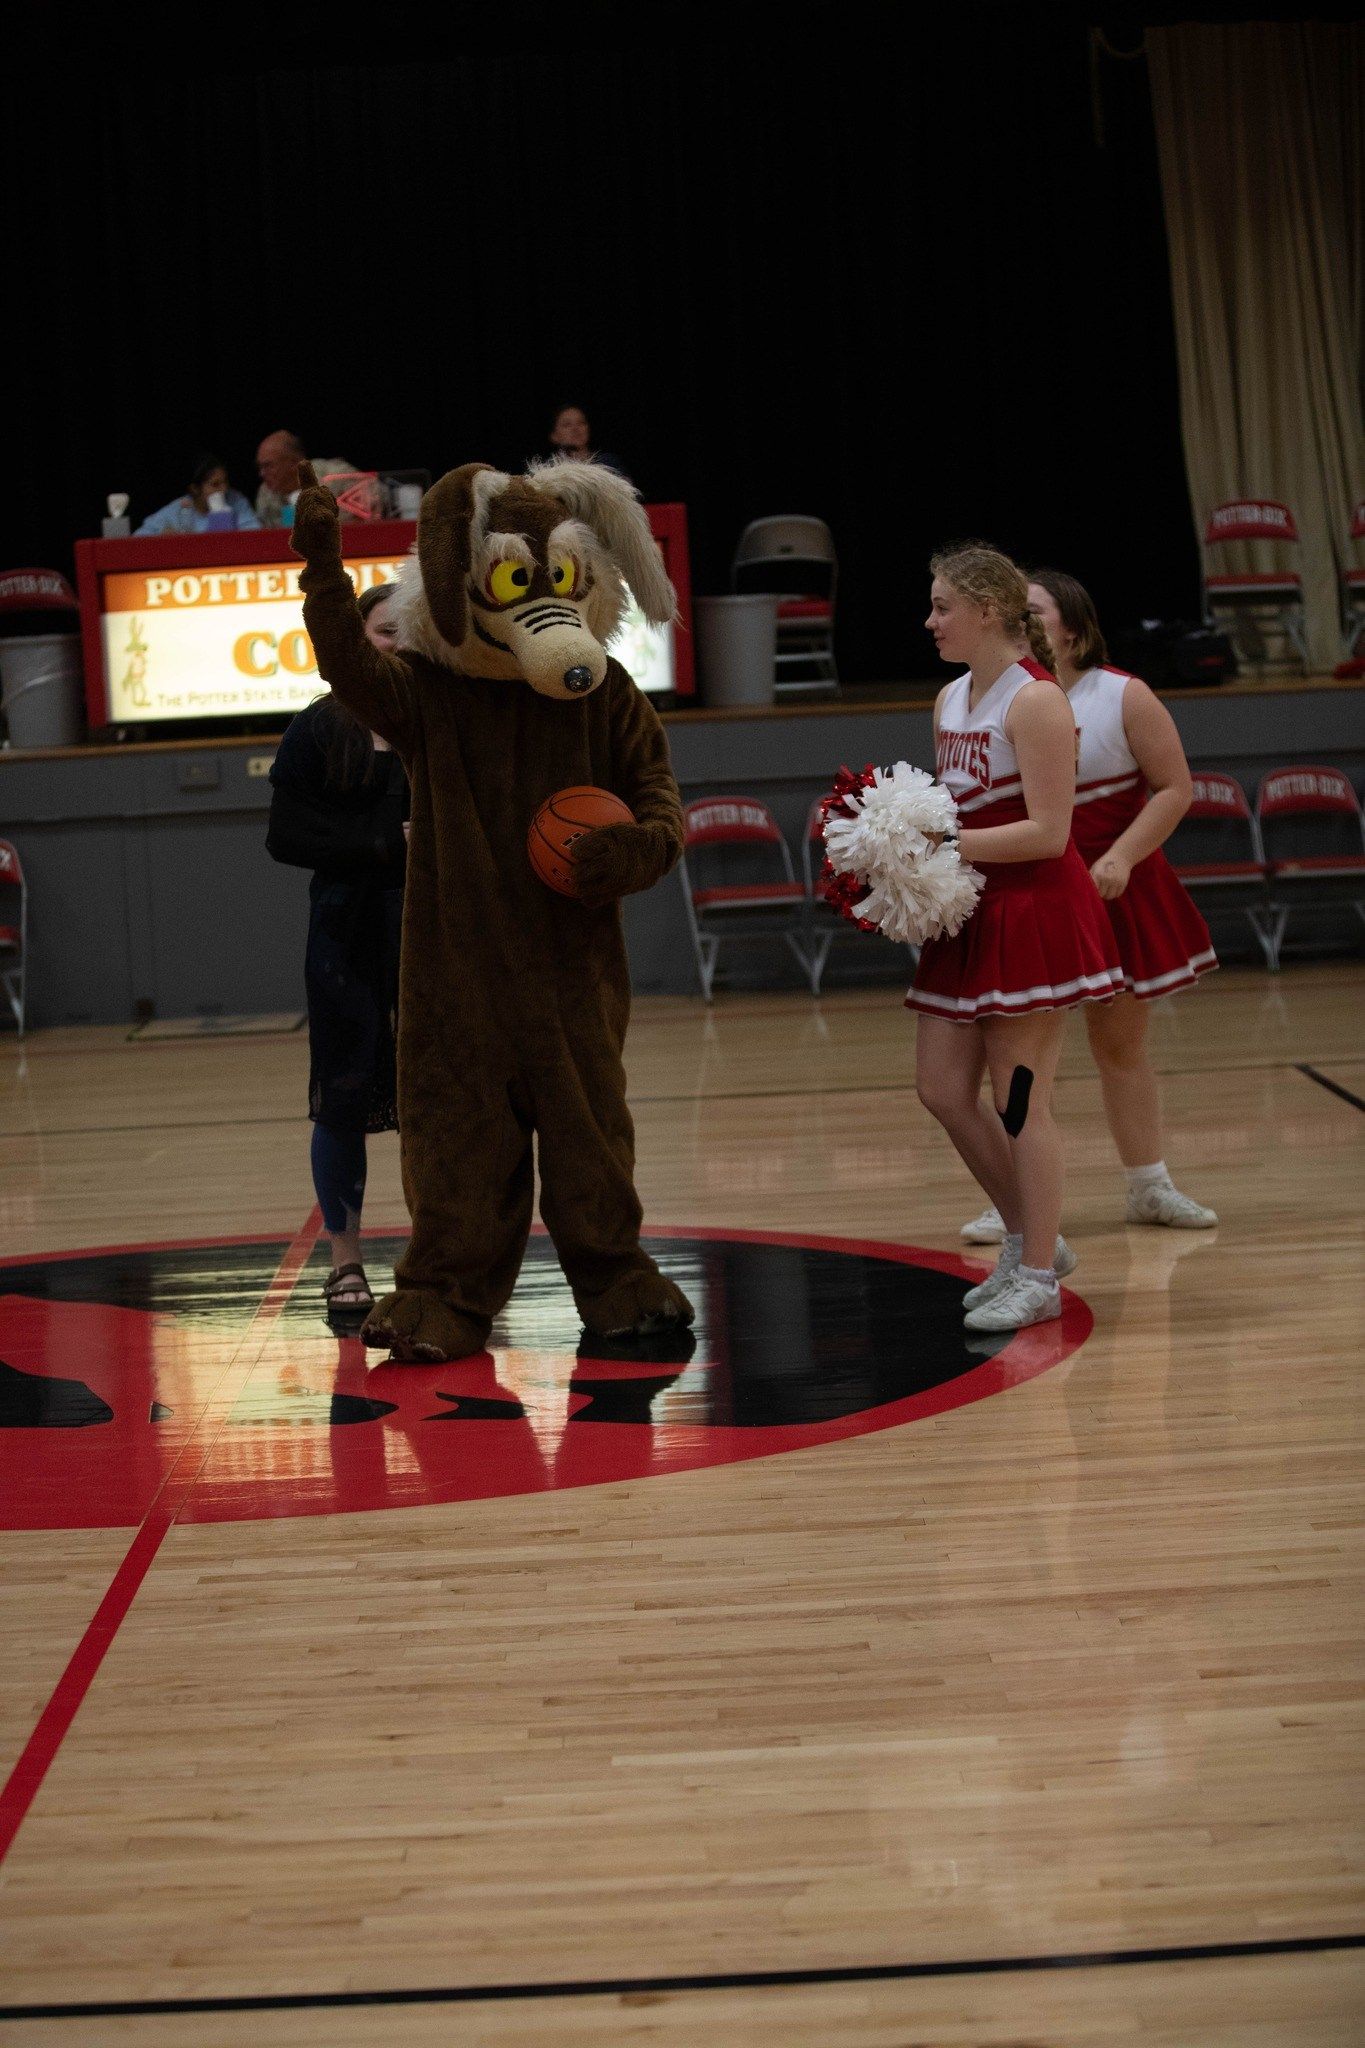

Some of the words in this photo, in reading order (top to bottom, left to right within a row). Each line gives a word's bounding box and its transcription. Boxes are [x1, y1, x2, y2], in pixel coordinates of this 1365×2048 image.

[157, 693, 181, 707] THE
[188, 690, 239, 706] POTTER
[243, 687, 283, 703] STATE
